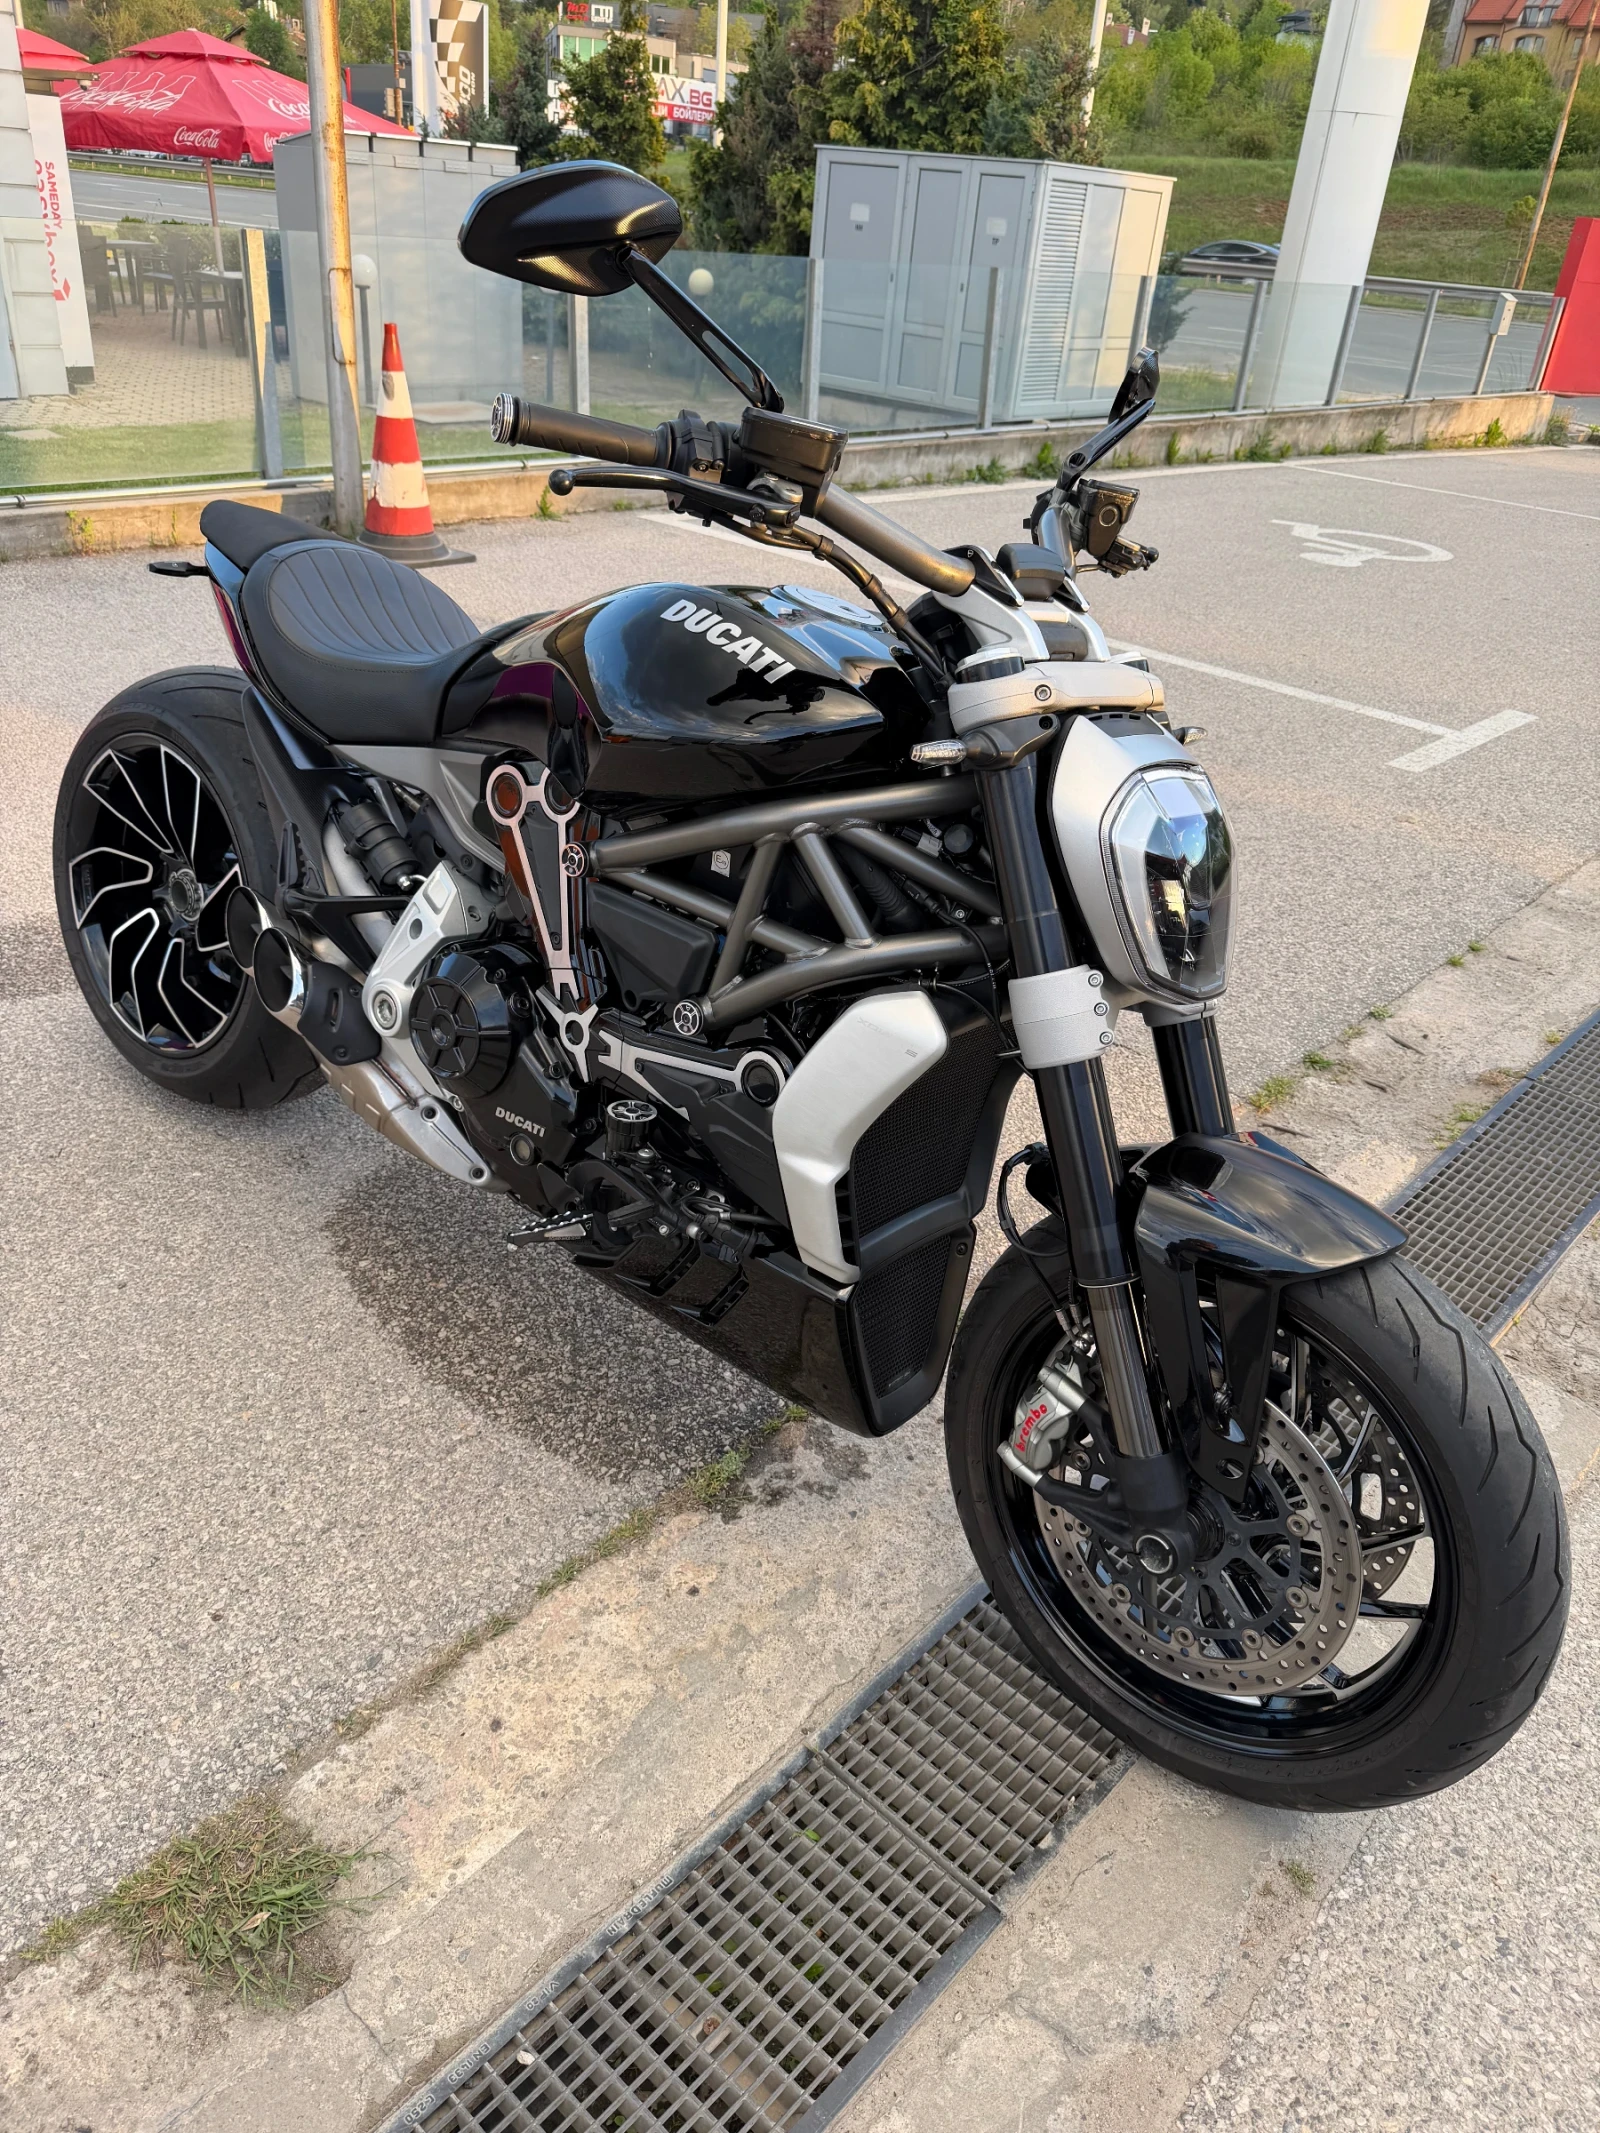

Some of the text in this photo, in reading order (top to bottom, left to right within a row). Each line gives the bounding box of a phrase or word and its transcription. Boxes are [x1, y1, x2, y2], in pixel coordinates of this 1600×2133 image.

[657, 77, 713, 107] AX.BG
[45, 161, 63, 229] SAMEDAY
[660, 599, 797, 684] DUCATI
[495, 1106, 546, 1138] DUCATI
[1014, 1403, 1048, 1453] brembo
[473, 2042, 491, 2061] EN
